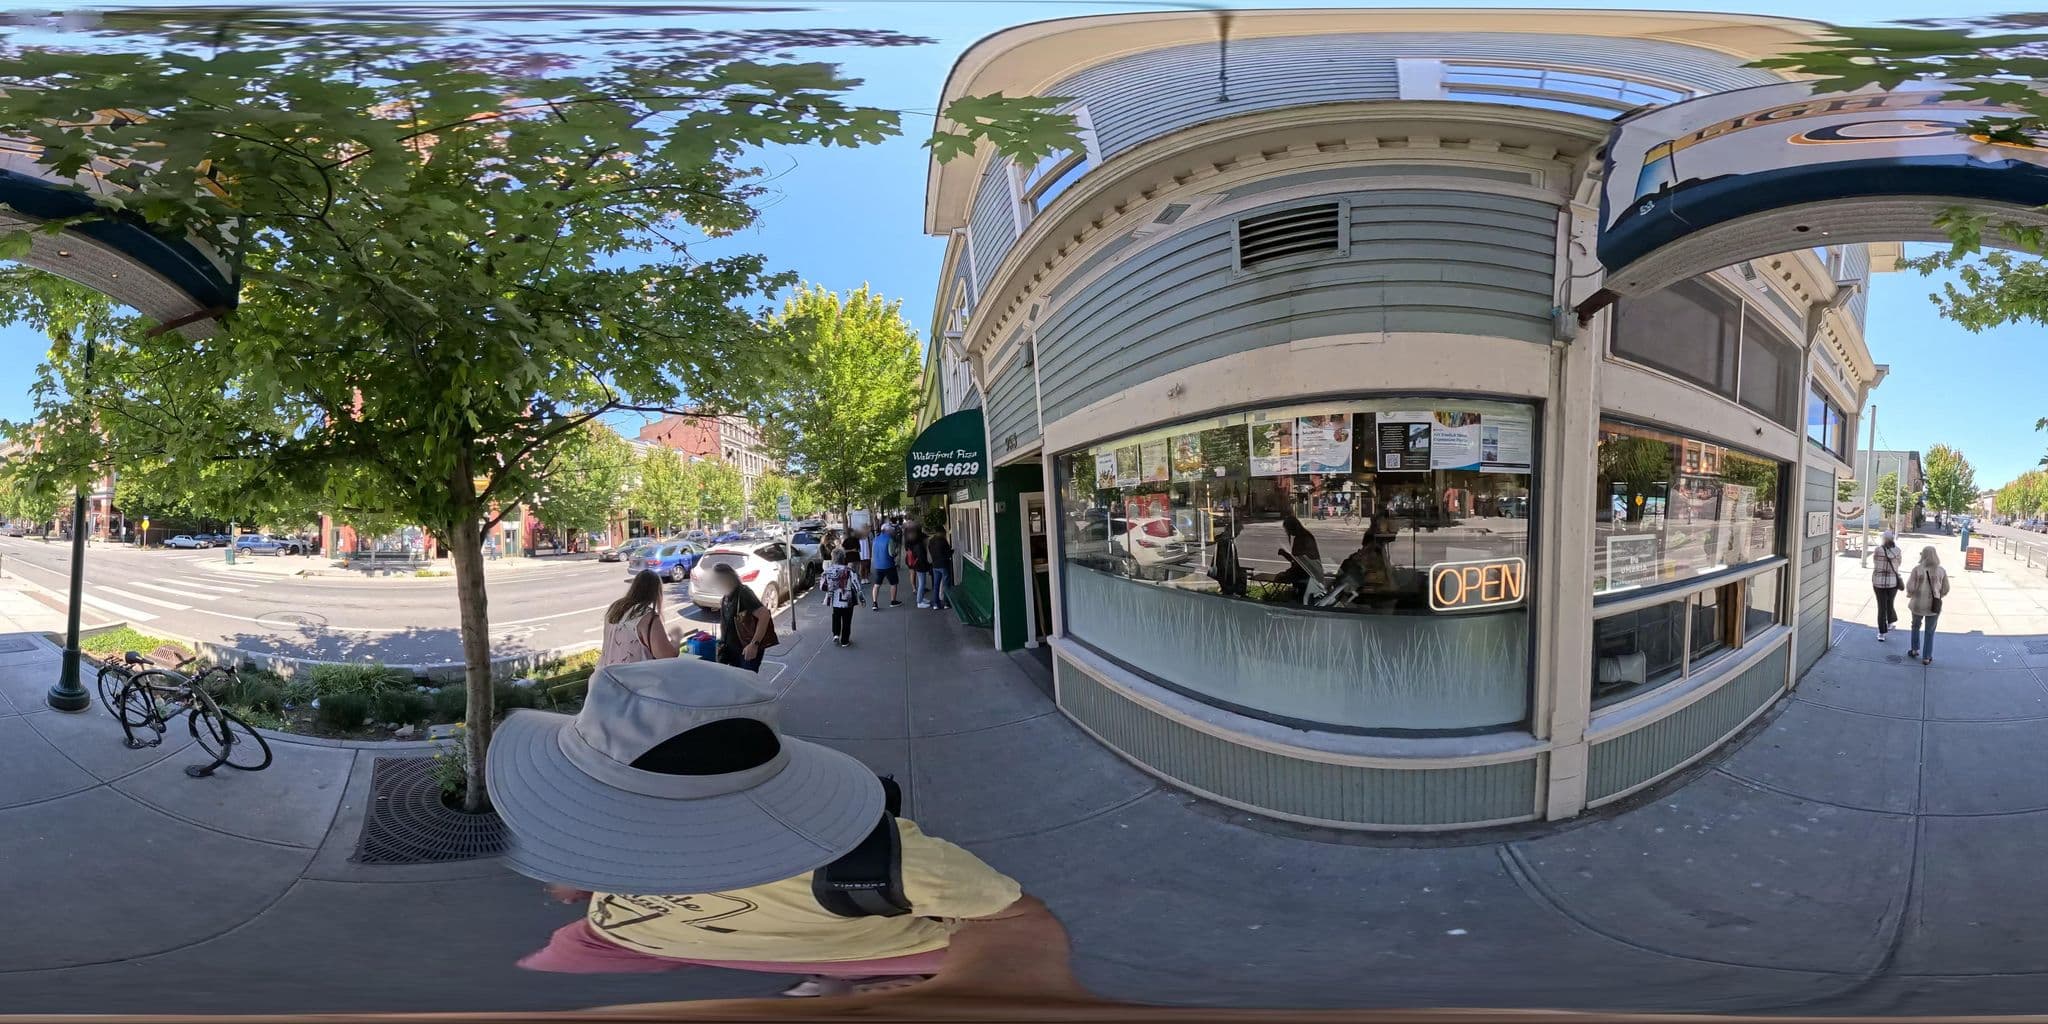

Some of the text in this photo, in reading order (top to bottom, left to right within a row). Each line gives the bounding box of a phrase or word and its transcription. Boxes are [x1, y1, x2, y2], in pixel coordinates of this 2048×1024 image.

[912, 449, 978, 462] Waterfront Pizza
[912, 461, 979, 479] 385-6629
[1435, 562, 1521, 606] OPEN
